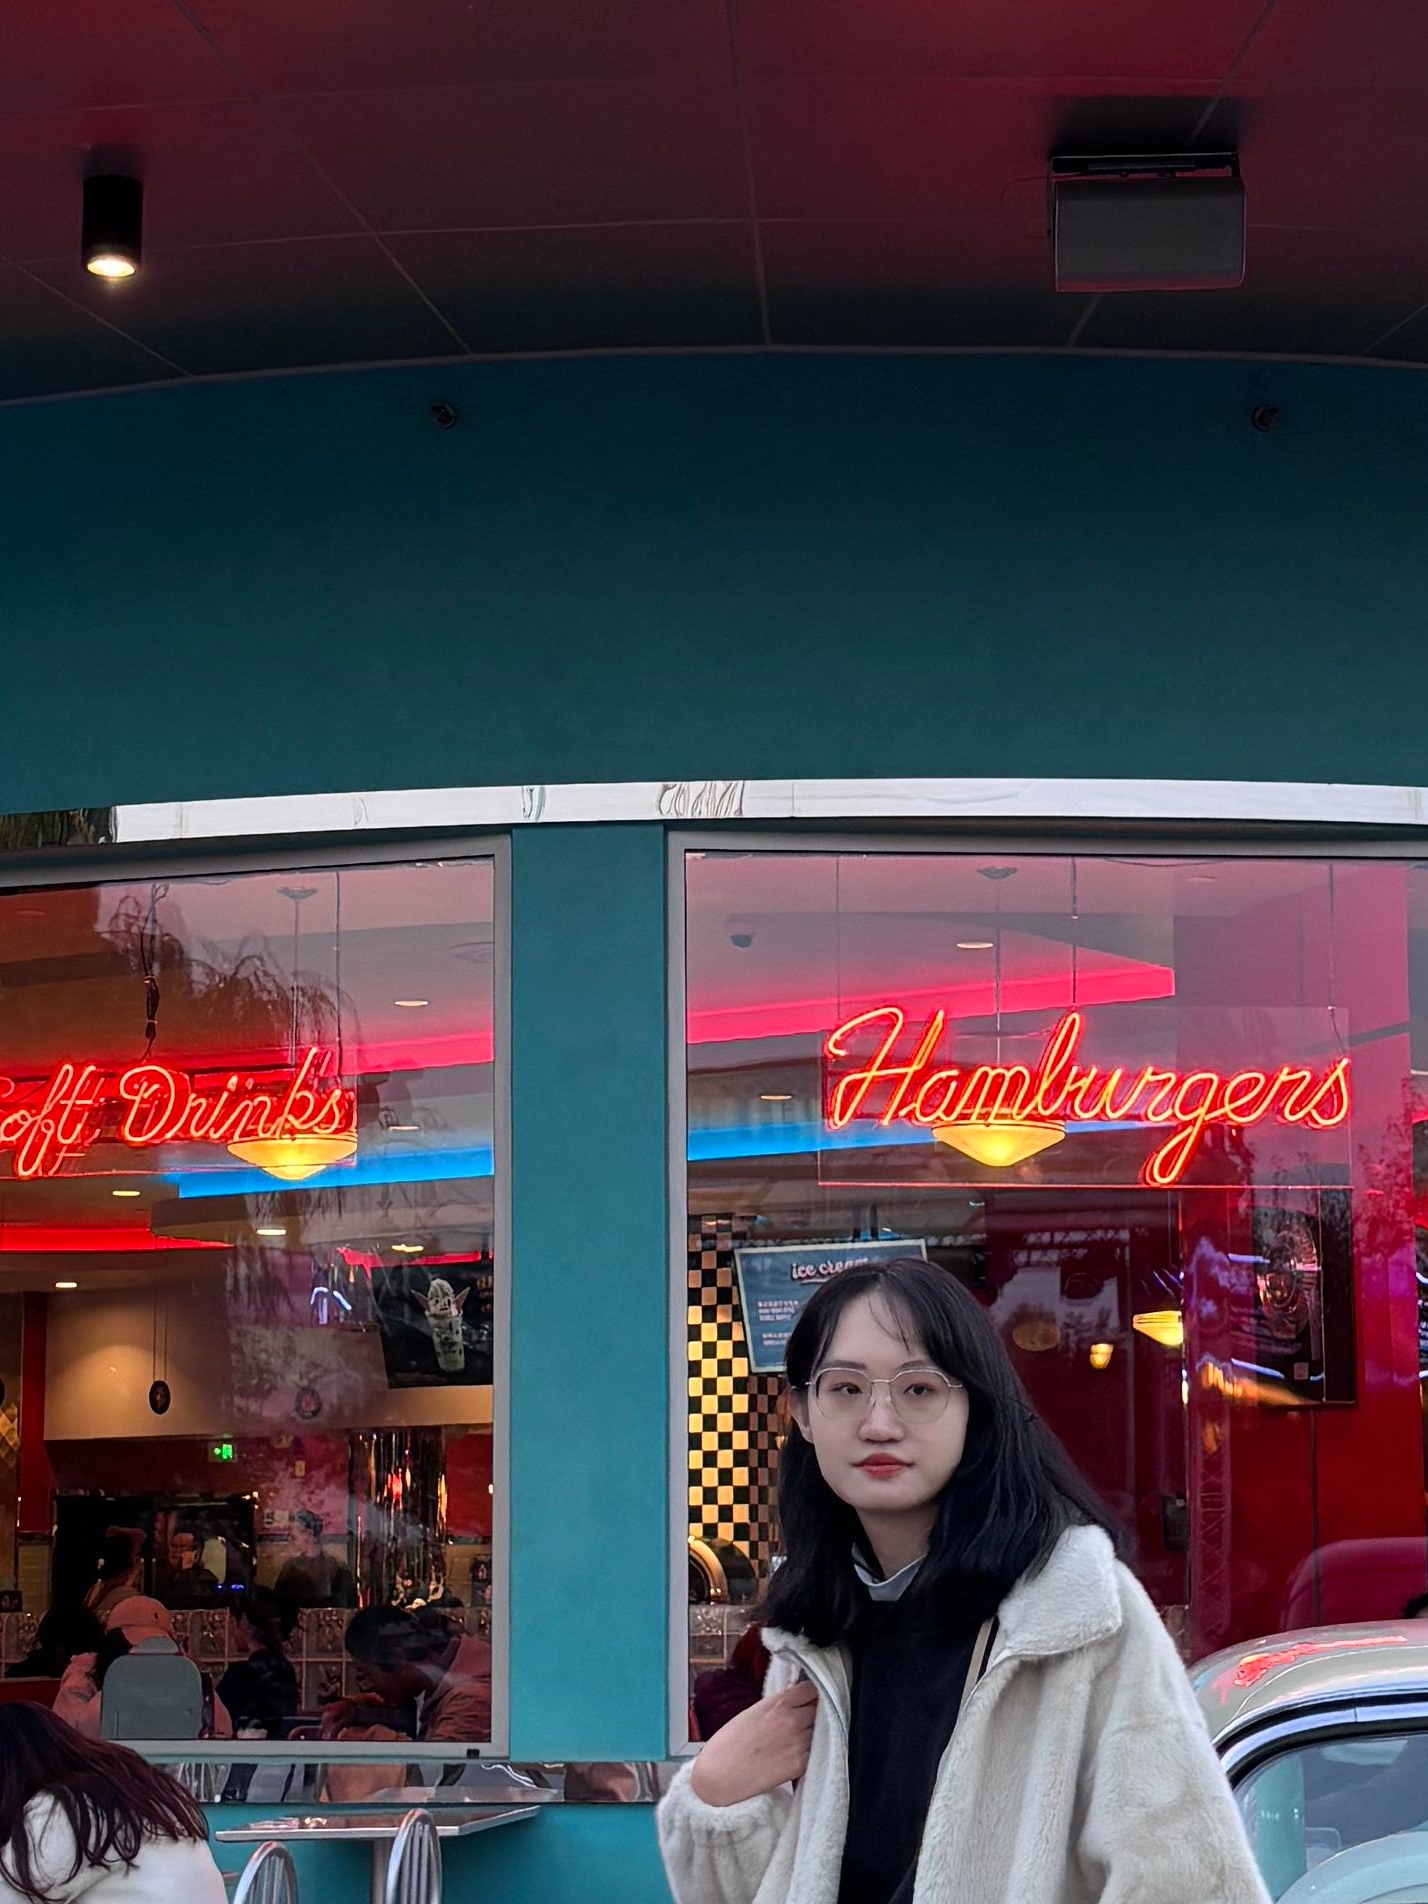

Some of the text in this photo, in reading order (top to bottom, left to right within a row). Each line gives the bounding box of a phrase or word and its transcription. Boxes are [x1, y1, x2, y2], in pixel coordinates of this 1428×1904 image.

[119, 1046, 347, 1142] Drinks
[823, 1006, 1352, 1185] Hamburgers
[791, 1261, 817, 1280] ice
